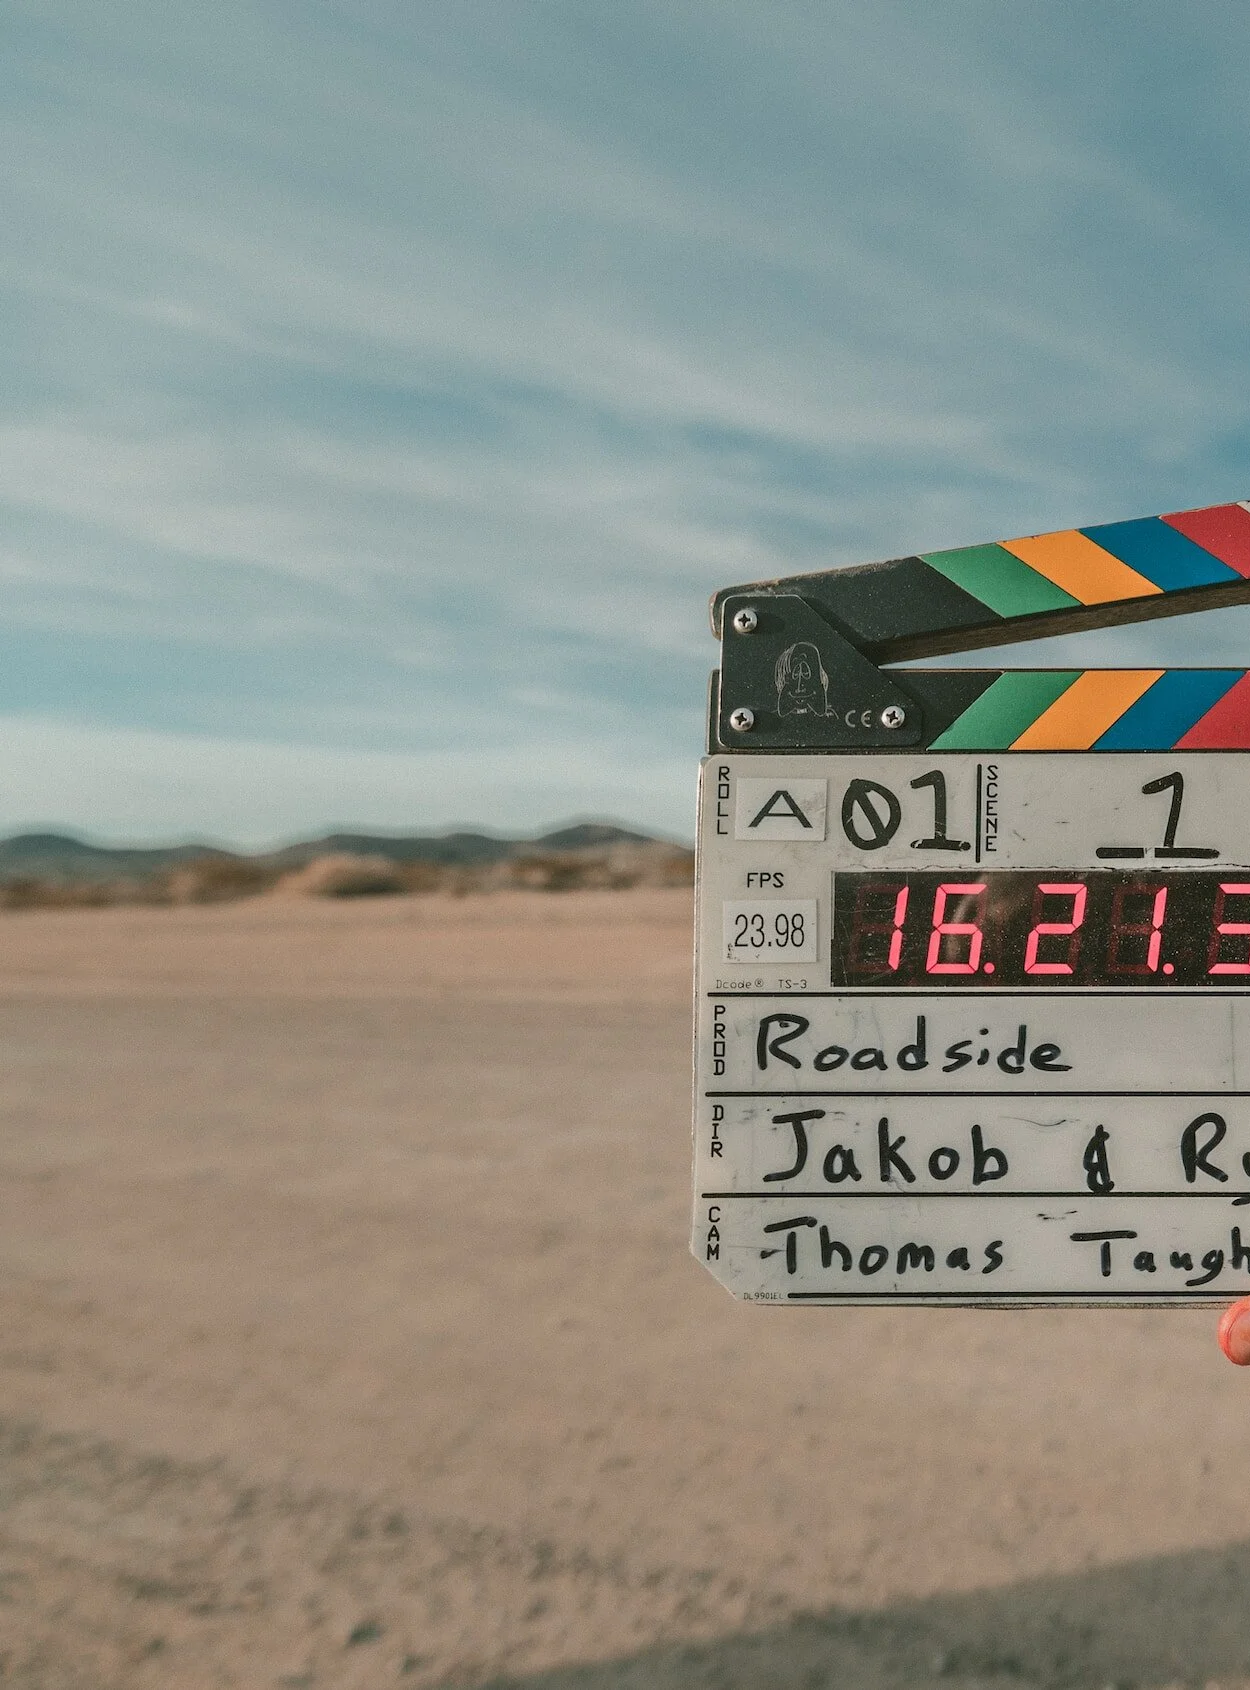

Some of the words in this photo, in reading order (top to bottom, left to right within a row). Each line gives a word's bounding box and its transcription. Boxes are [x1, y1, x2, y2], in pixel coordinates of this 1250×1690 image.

[716, 766, 731, 836] ROLL
[747, 790, 814, 828] A
[985, 764, 999, 853] SCENE
[1096, 771, 1220, 858] 1
[746, 871, 785, 889] FPS
[733, 912, 806, 949] 23.98
[778, 979, 808, 989] TS-3
[713, 1005, 726, 1077] PROD
[756, 1013, 1073, 1075] Roadside
[710, 1105, 724, 1159] DIR
[762, 1108, 1010, 1186] Jakob
[707, 1206, 721, 1262] CAM
[762, 1215, 1005, 1276] Thomas
